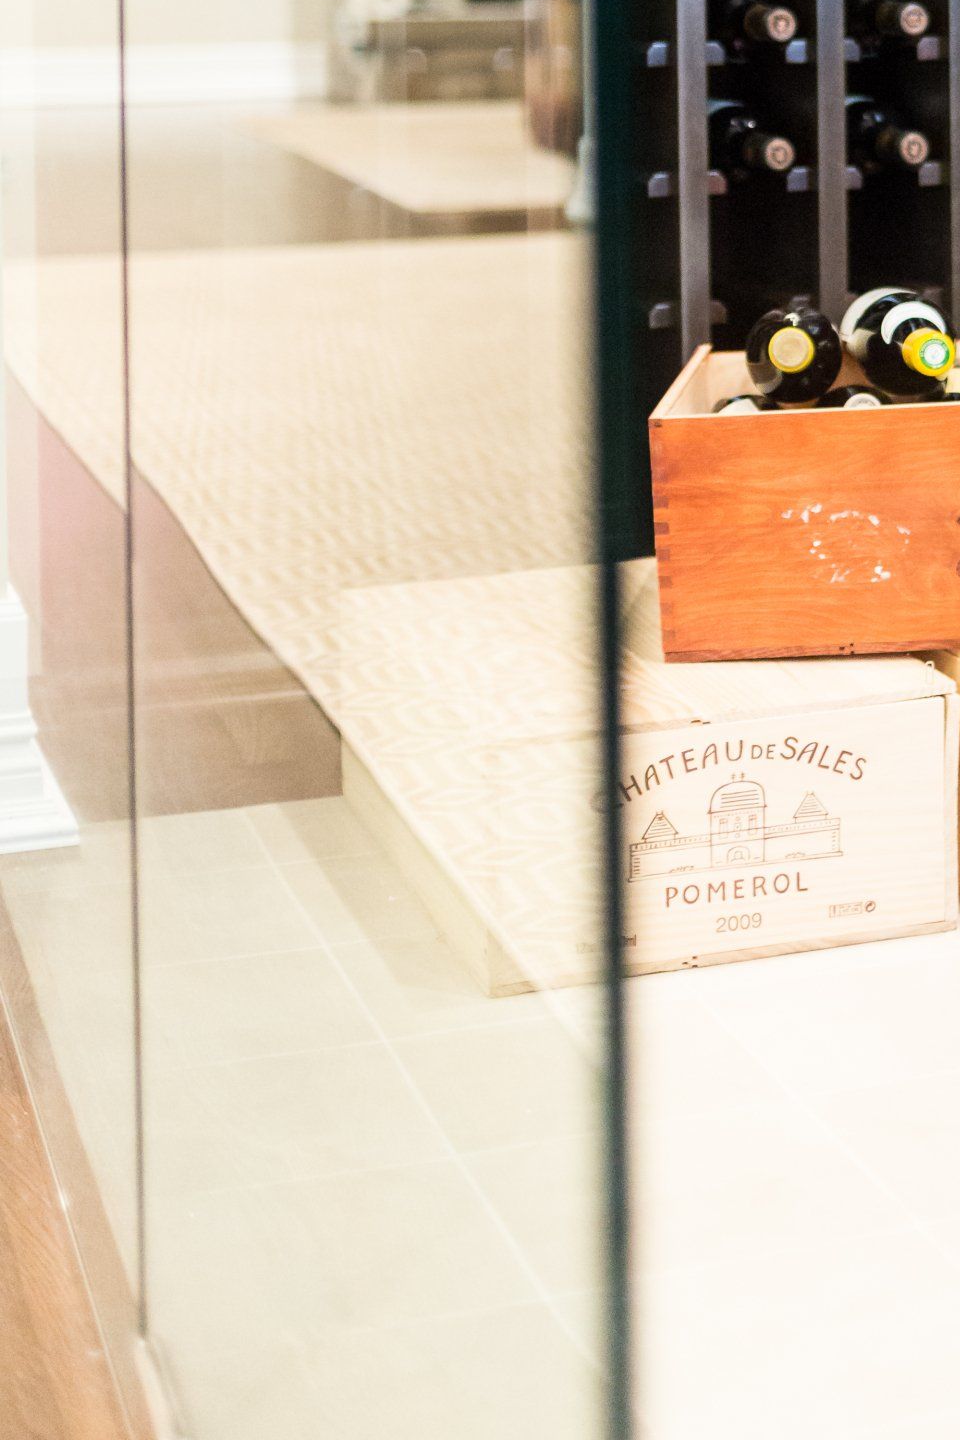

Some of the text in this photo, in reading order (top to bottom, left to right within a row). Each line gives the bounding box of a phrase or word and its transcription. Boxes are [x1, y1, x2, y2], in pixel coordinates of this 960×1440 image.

[619, 740, 744, 803] HATEAU
[779, 736, 867, 782] SALES
[665, 872, 809, 908] POMEROL
[716, 913, 762, 934] 2009
